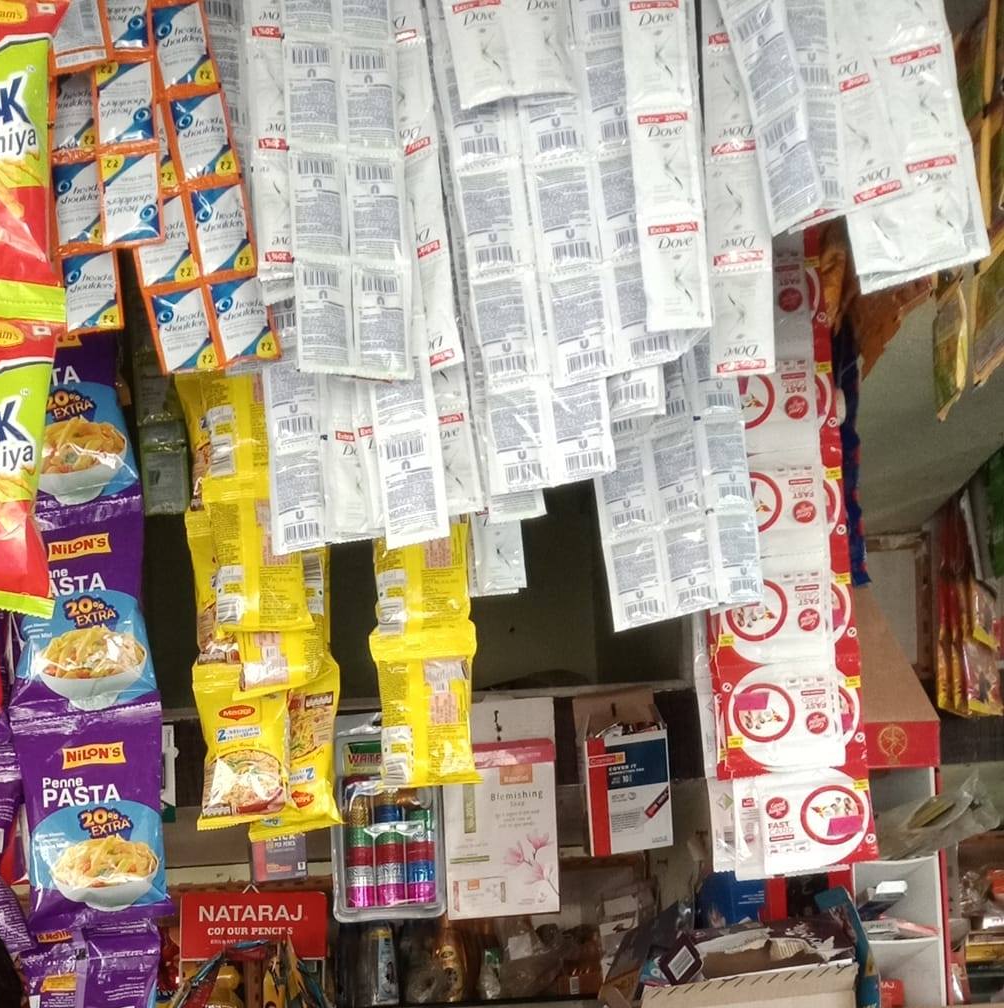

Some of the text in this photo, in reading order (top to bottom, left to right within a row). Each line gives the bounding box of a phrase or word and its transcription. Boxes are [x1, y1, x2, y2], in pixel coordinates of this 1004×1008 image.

[464, 11, 496, 27] Dove
[639, 12, 675, 27] Dove
[901, 59, 937, 78] Dove
[648, 125, 683, 138] Dove
[857, 166, 891, 187] Dove
[203, 220, 245, 233] shoulders
[658, 236, 693, 250] Dove
[721, 234, 756, 249] Dove
[70, 282, 114, 294] shoulders
[223, 309, 265, 322] shoulders
[164, 319, 206, 332] shoulders
[724, 344, 759, 358] Dove
[53, 400, 94, 418] EXTRA
[52, 536, 107, 556] NILON'S
[65, 597, 105, 618] 20%
[76, 609, 116, 627] EXTRA
[223, 707, 253, 717] Maggi
[66, 746, 121, 762] NILON'S
[42, 777, 83, 789] Penne
[43, 784, 121, 808] PASTA
[490, 790, 543, 801] Blemishing
[81, 808, 117, 828] 20%
[768, 821, 789, 830] FAST
[91, 819, 131, 836] EXTRA
[198, 904, 303, 922] NATARAJ
